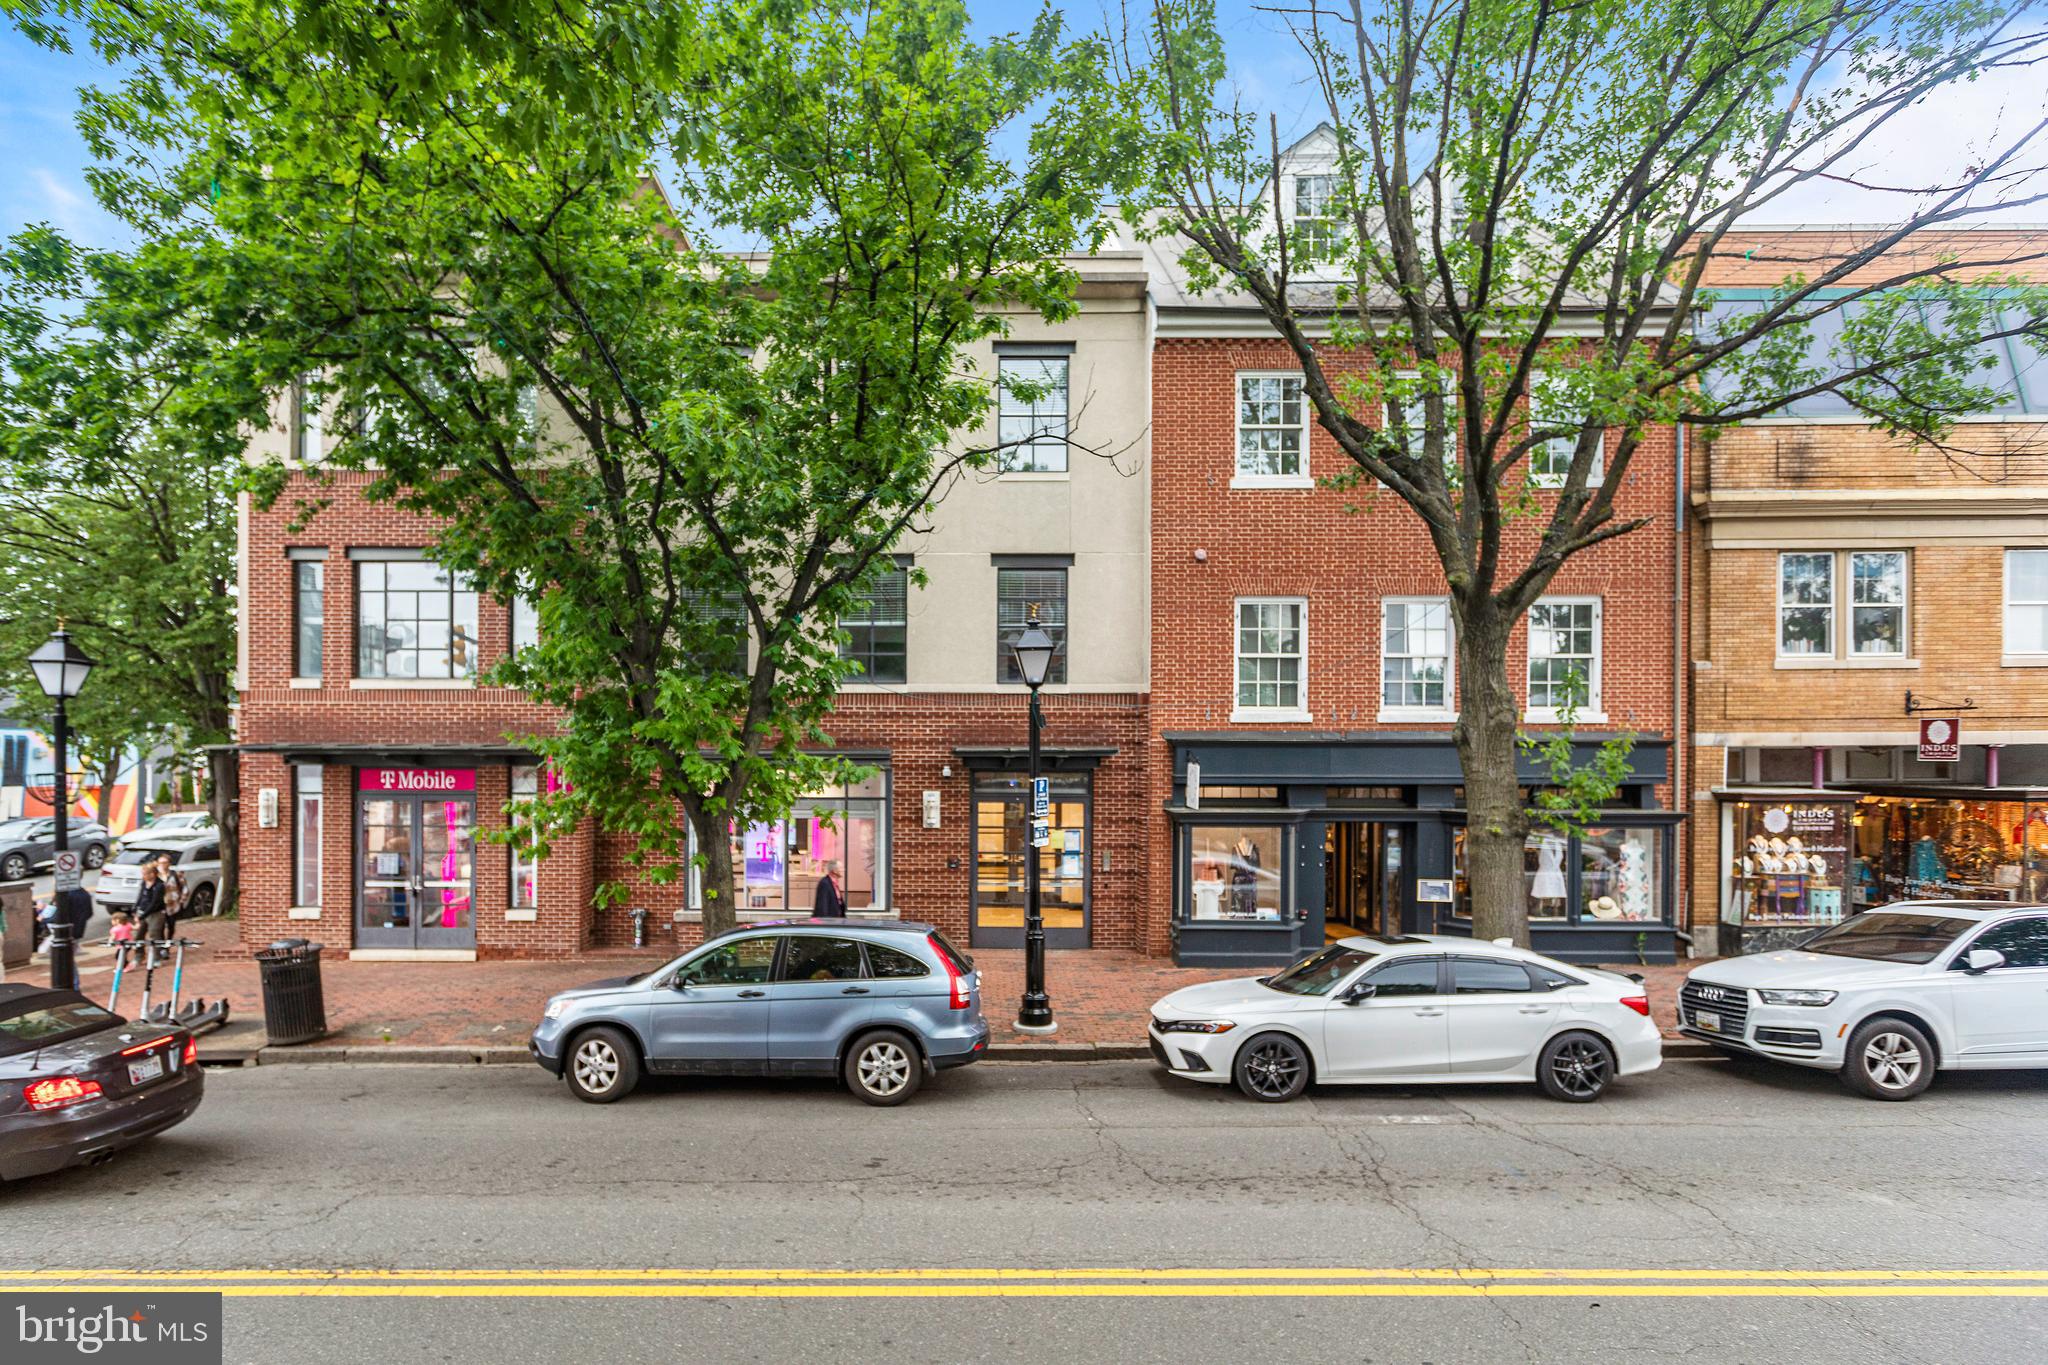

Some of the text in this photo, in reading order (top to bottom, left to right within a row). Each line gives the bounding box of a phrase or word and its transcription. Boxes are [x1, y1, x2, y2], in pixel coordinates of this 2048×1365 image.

[1921, 744, 1957, 752] INDUS
[397, 771, 456, 789] Mobile
[1793, 809, 1834, 818] INDUS
